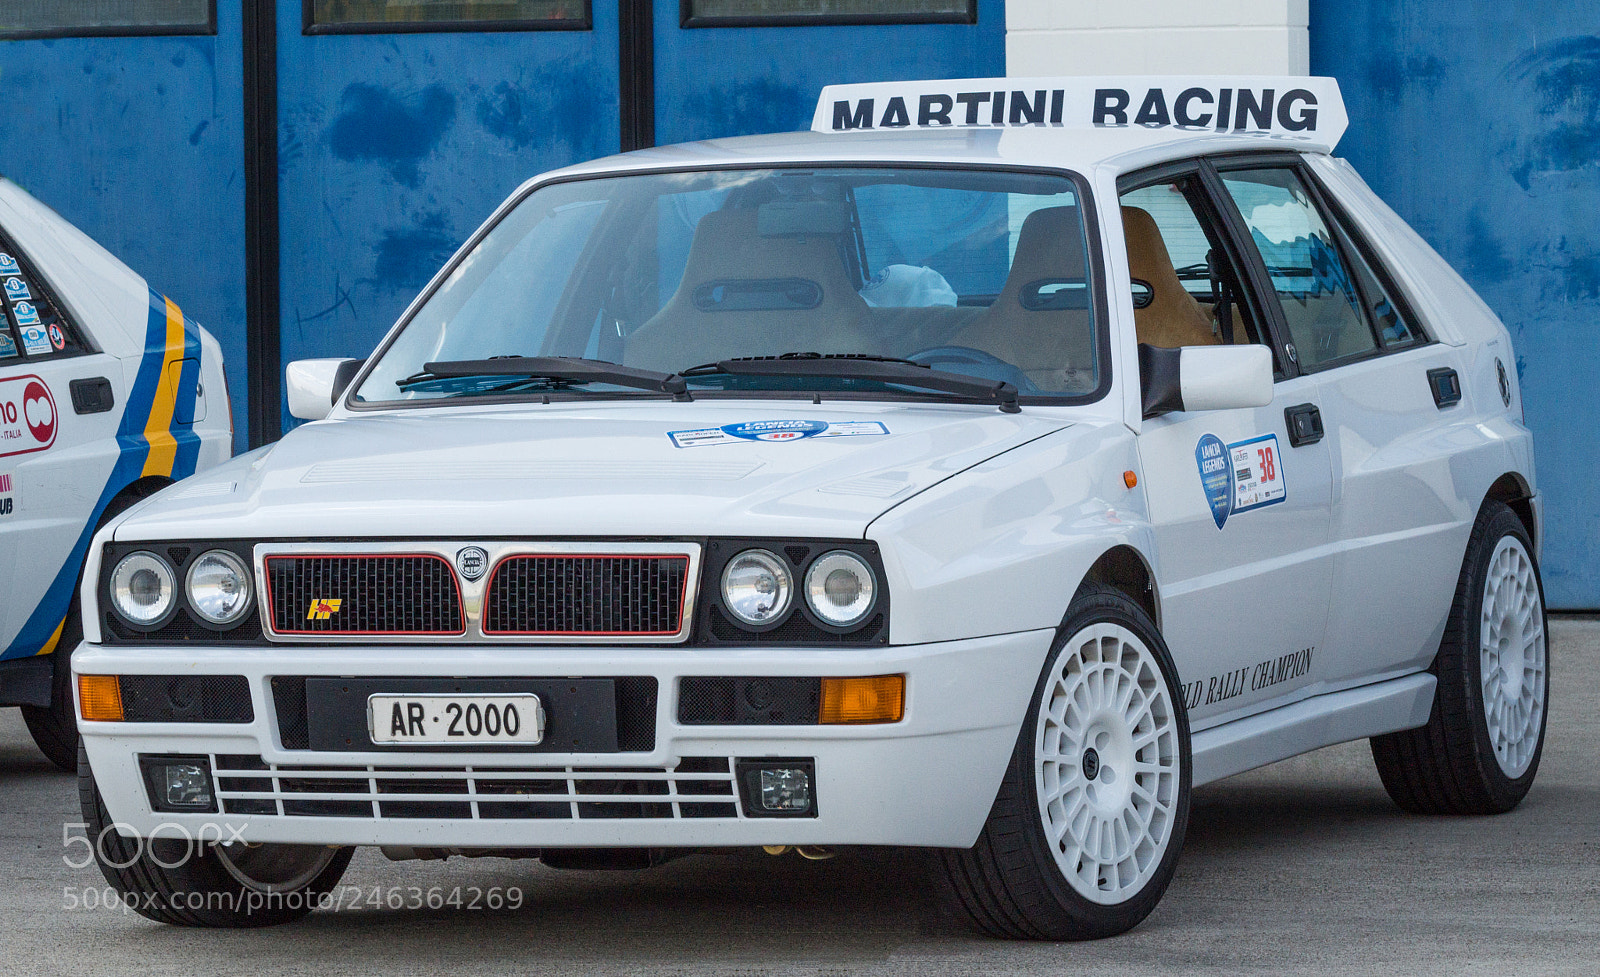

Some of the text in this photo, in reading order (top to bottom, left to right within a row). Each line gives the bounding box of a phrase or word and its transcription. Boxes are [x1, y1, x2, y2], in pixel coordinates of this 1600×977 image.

[832, 87, 1318, 131] MARTINI RACING
[1257, 447, 1275, 483] 38
[1205, 666, 1249, 705] RALLY
[1251, 646, 1315, 691] CHAMPION
